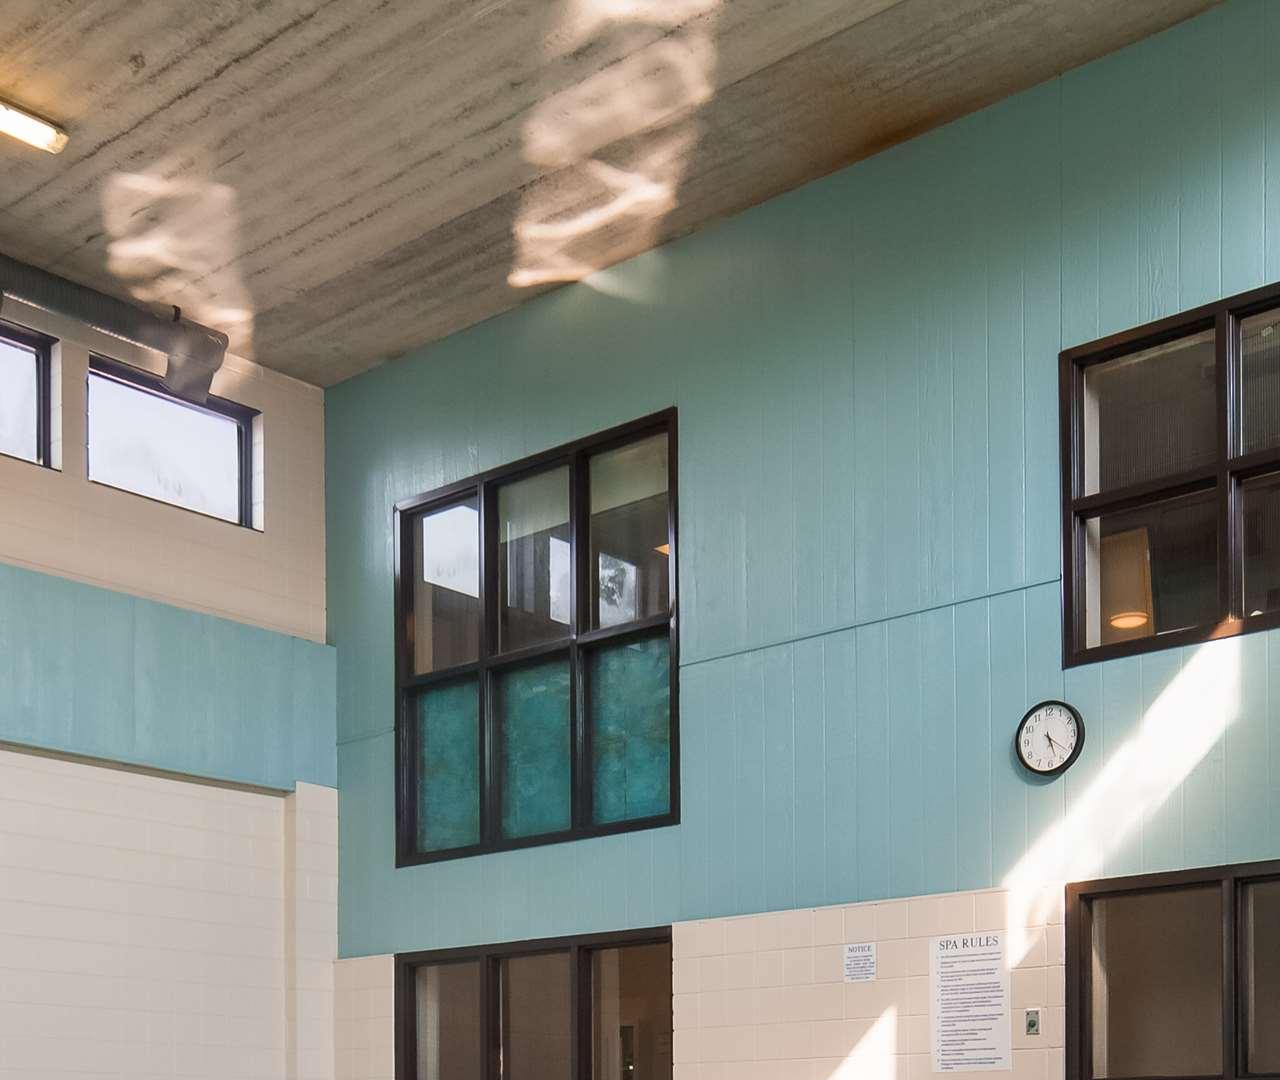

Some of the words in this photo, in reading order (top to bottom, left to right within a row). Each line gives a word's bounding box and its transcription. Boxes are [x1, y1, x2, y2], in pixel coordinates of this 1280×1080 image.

[1046, 707, 1054, 717] 12
[1034, 714, 1041, 723] 11
[1026, 725, 1034, 734] 10
[1024, 739, 1030, 748] 9
[1027, 751, 1033, 759] 8
[1048, 760, 1054, 768] 6
[939, 939, 958, 951] SPA
[962, 935, 1000, 949] RULES
[848, 945, 873, 953] NOTICE
